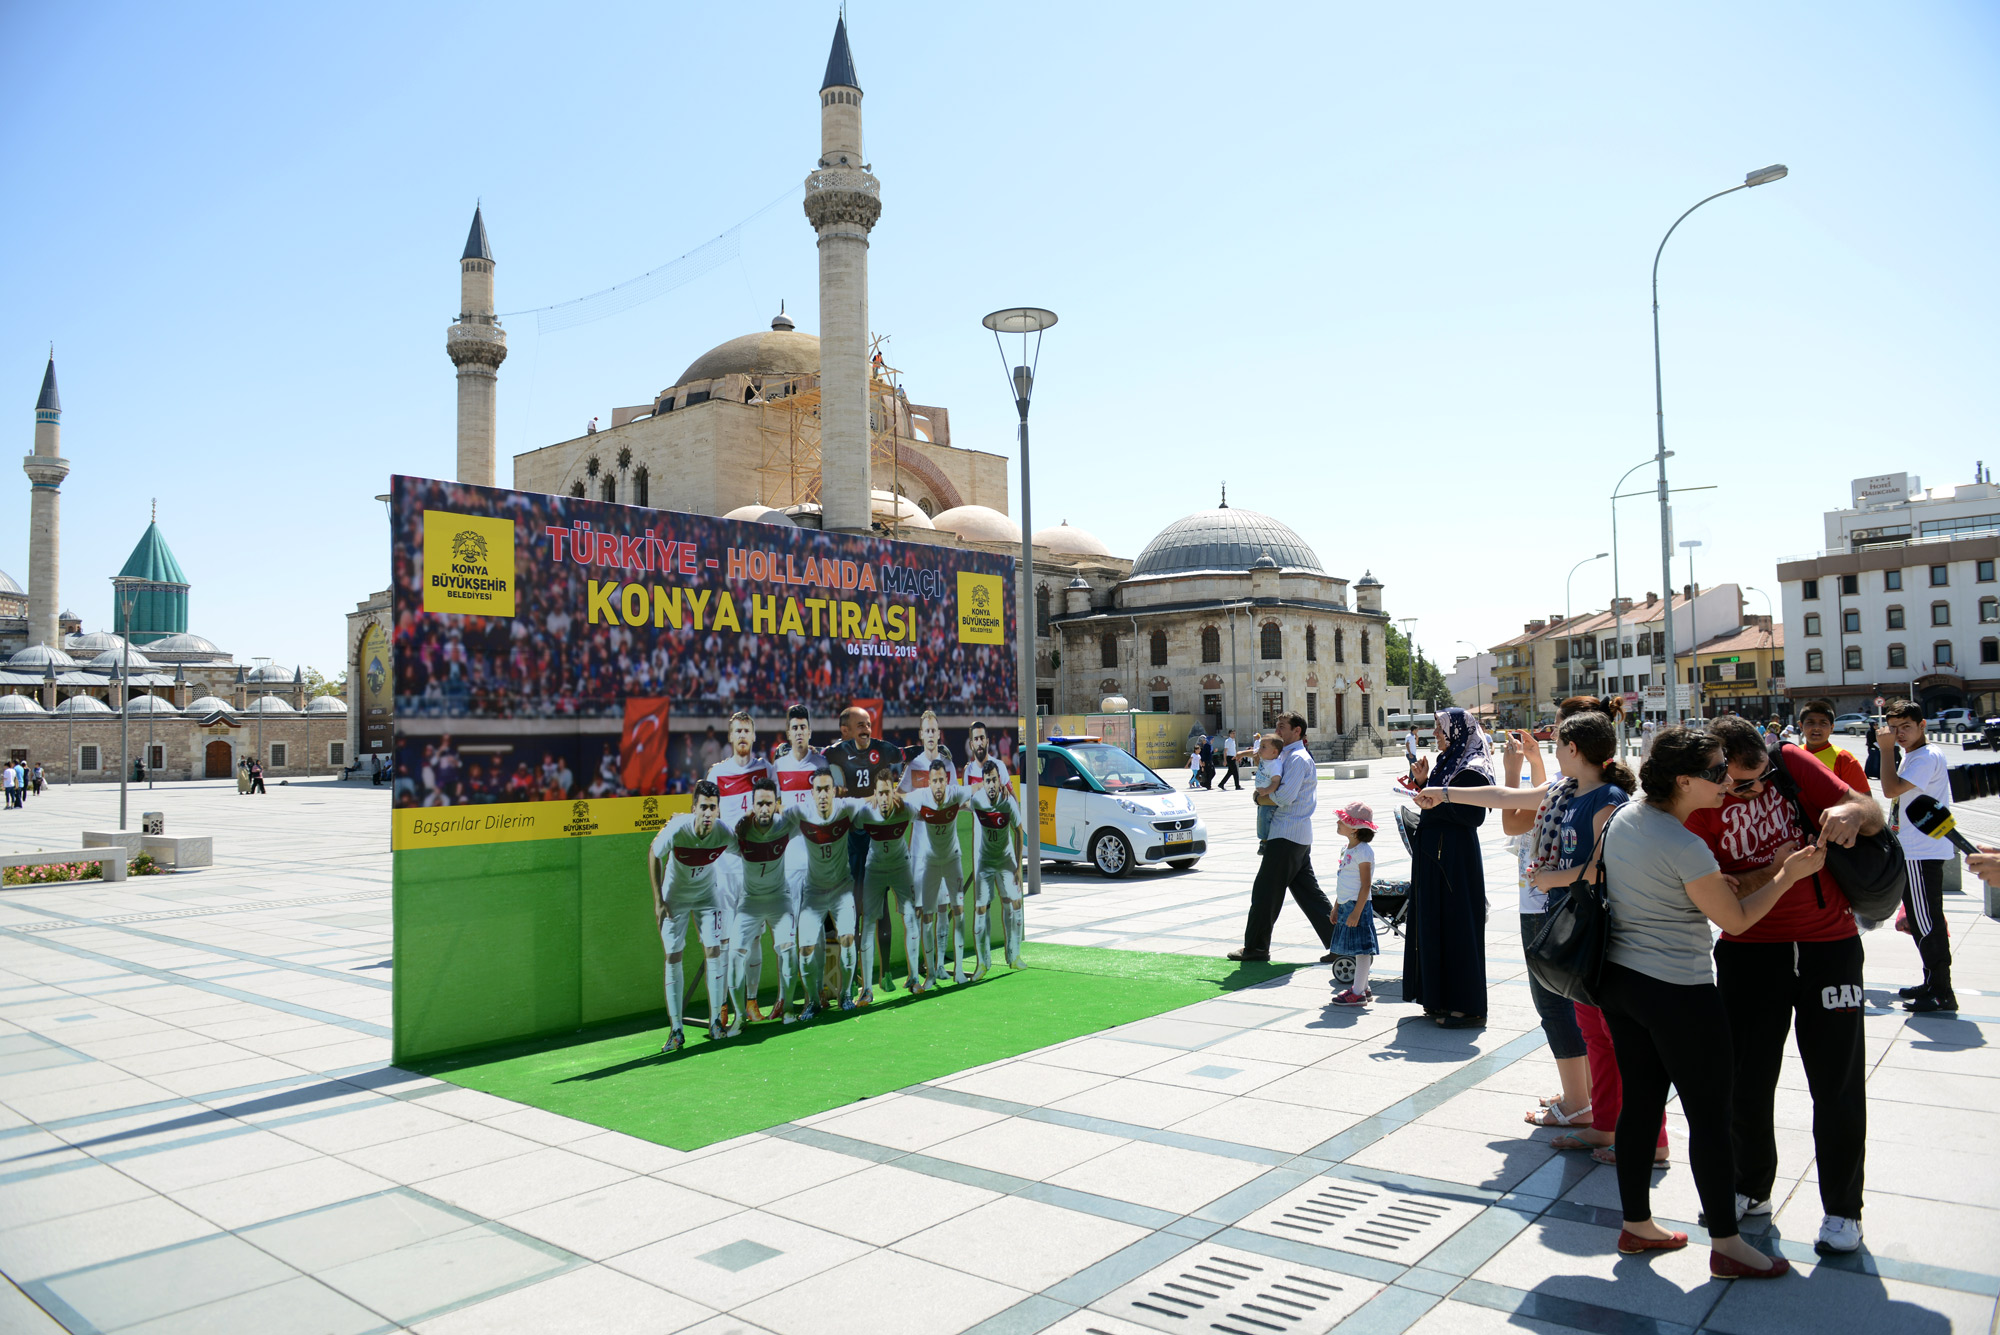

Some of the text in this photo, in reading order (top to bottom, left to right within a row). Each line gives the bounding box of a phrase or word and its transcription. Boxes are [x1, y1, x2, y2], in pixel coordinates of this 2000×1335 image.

[546, 520, 698, 575] TÜRKİYE
[727, 547, 877, 592] HOLLANDA
[882, 564, 941, 600] MAÇI
[451, 563, 488, 576] KONYA
[432, 572, 507, 592] BÜYÜKŞEHİR
[447, 590, 492, 600] BELEDİYESİ
[587, 579, 917, 642] KONYA HATIRASI
[971, 608, 990, 616] KONYA
[962, 615, 1000, 627] BÜYÜKŞEHİR
[847, 642, 917, 657] 06 EYLÜL 2015
[856, 769, 870, 788] 23
[741, 795, 748, 812] 4
[1721, 785, 1784, 836] Blue
[413, 813, 535, 836] Başarılar Dilerim
[563, 822, 599, 832] BÜYÜKŞEHİR
[935, 825, 947, 835] 22
[987, 829, 998, 842] 20
[820, 844, 832, 859] 19
[883, 841, 889, 853] 5
[760, 863, 767, 878] 7
[713, 910, 722, 930] 13
[1821, 984, 1862, 1010] GAP
